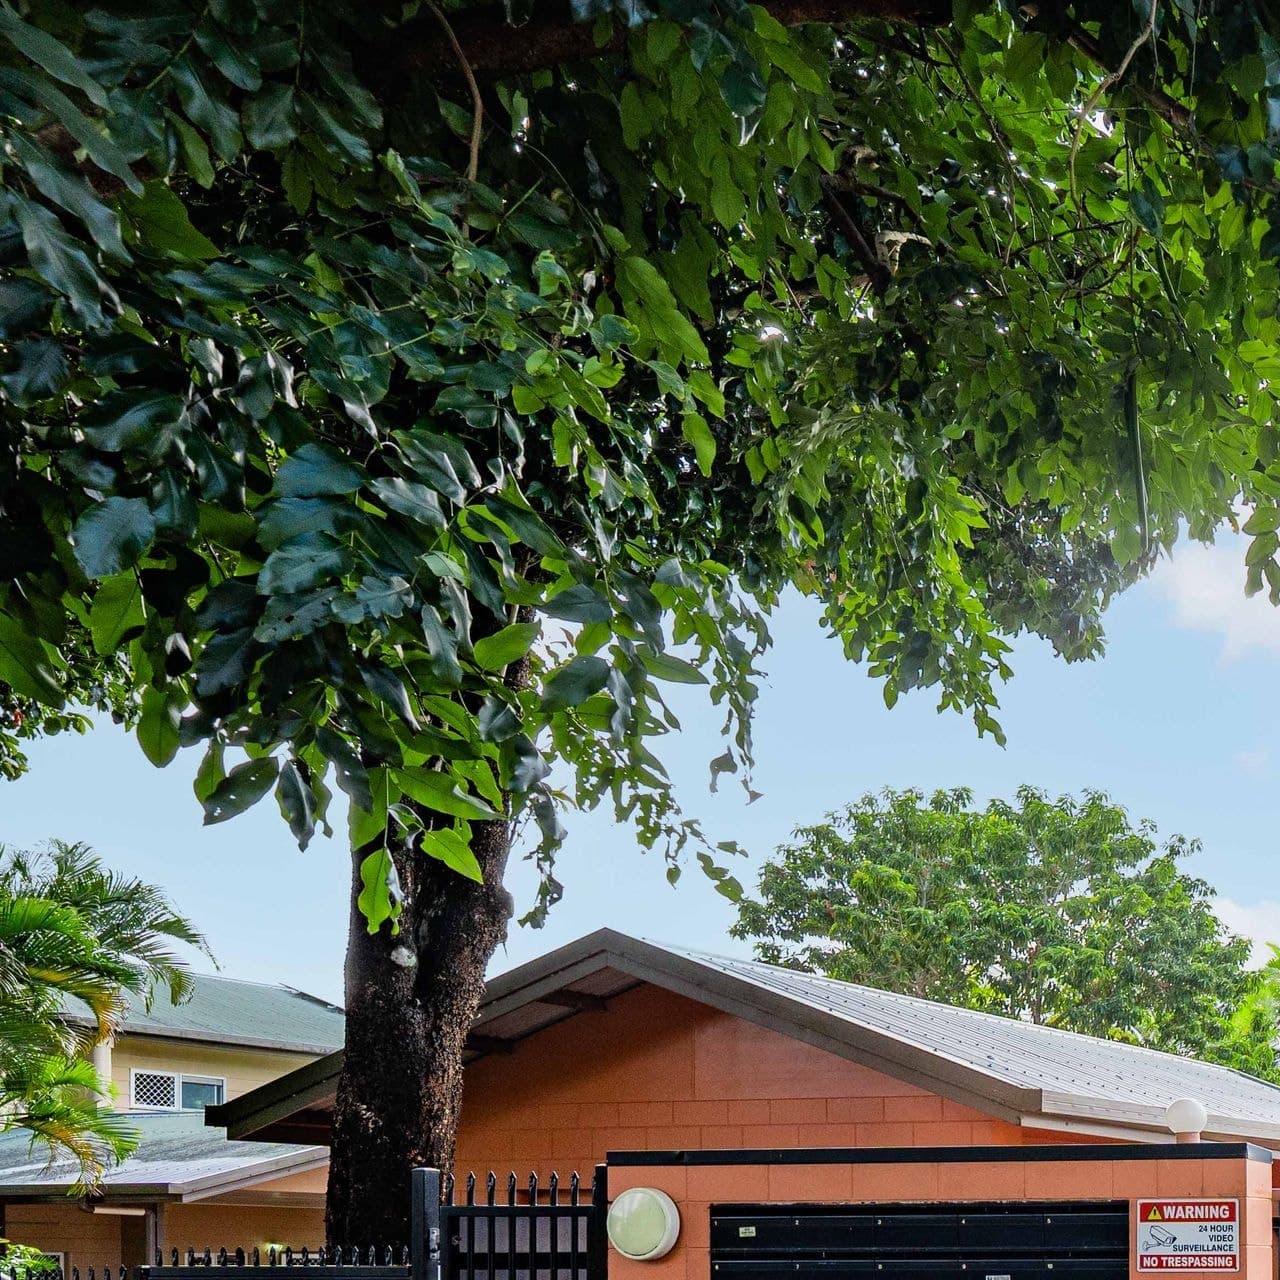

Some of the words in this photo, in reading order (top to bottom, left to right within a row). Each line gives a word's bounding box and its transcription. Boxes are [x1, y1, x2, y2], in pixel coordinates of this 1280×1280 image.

[1163, 1205, 1230, 1219] WARNING
[1173, 1244, 1234, 1252] SURVEILLANCE
[1143, 1257, 1158, 1267] NO
[1161, 1256, 1233, 1267] TRESPASSING
